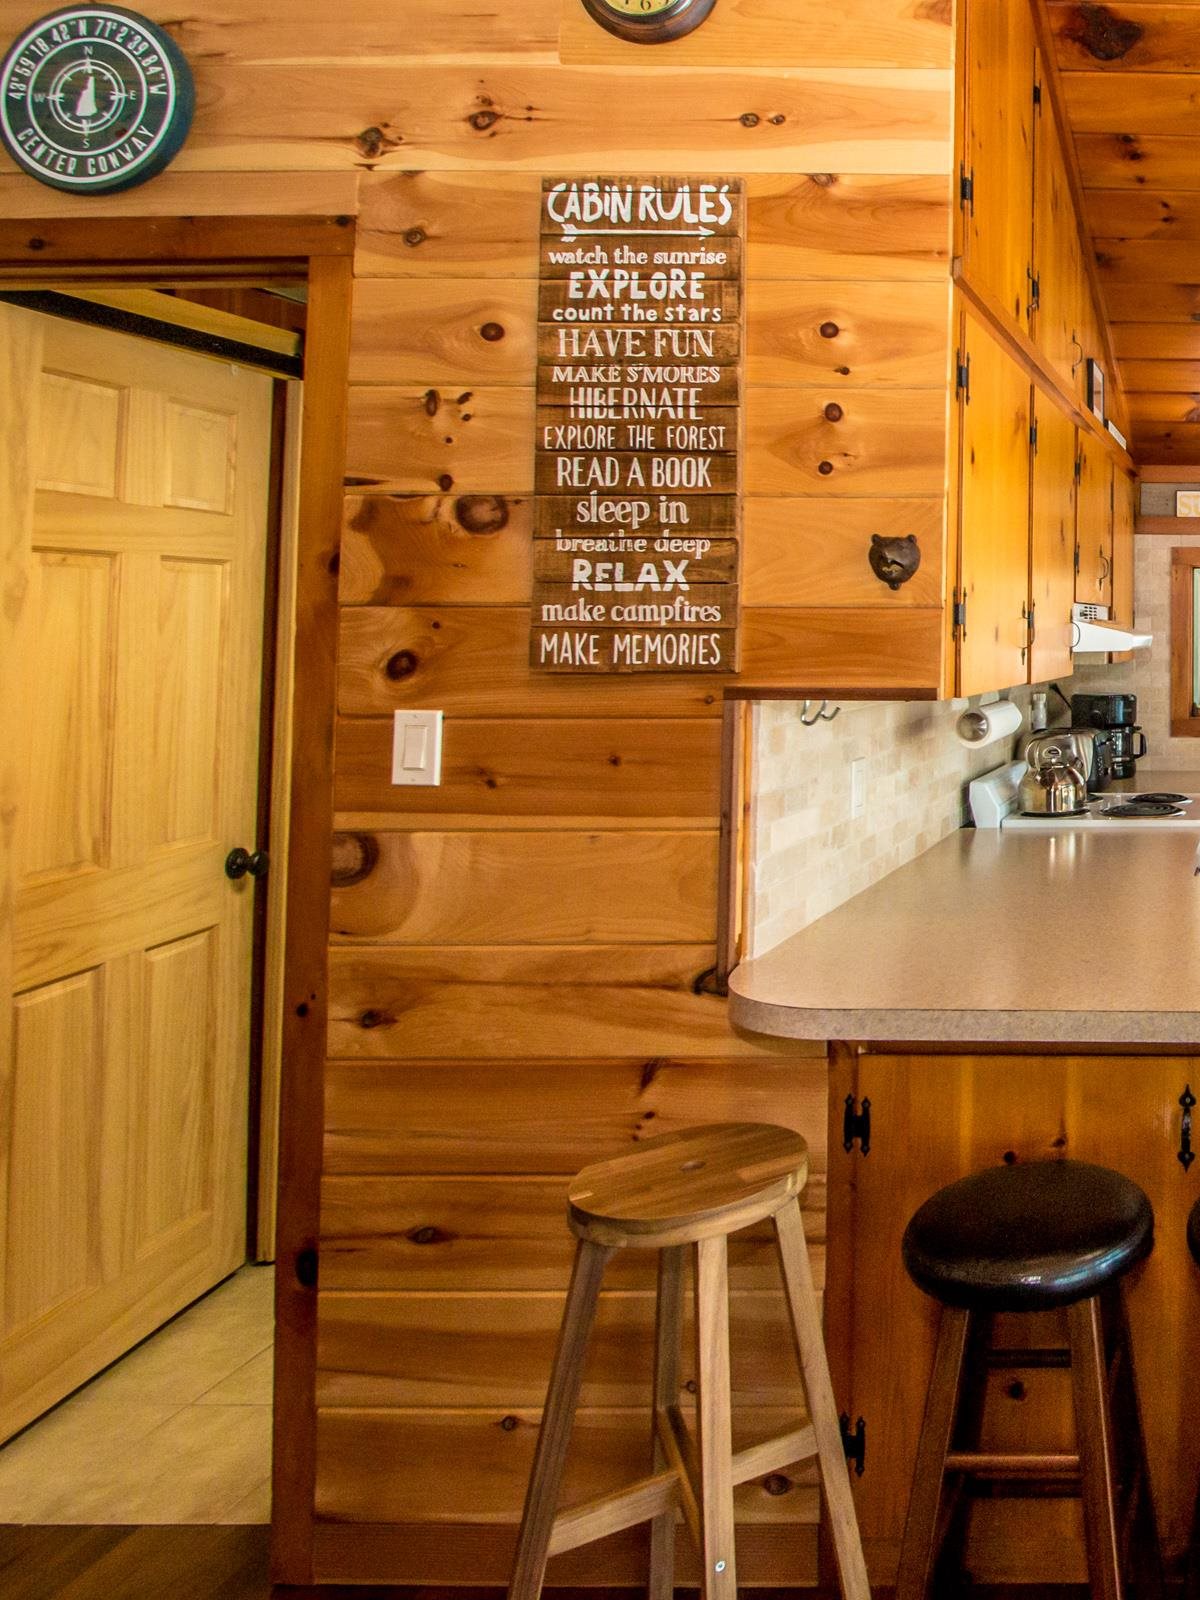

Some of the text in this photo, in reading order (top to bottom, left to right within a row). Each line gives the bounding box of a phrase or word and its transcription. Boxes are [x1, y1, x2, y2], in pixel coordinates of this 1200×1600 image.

[16, 124, 155, 175] CENTER CONWAY
[639, 184, 732, 225] RULES
[548, 246, 727, 265] watch the sunrise
[569, 268, 706, 300] EXPLORE
[552, 304, 721, 322] count the stars
[558, 328, 715, 358] HAVE FUN
[552, 366, 621, 383] MAKE
[570, 387, 704, 420] HIBERNATE
[544, 425, 726, 450] EXPLORE THE FOREST
[557, 457, 712, 487] READ A BOOK
[577, 490, 690, 529] sleep in
[555, 529, 711, 559] breathe deep
[572, 558, 690, 592] RELAX
[542, 596, 721, 626] make campfires
[540, 632, 721, 665] MAKE MEMORIES
